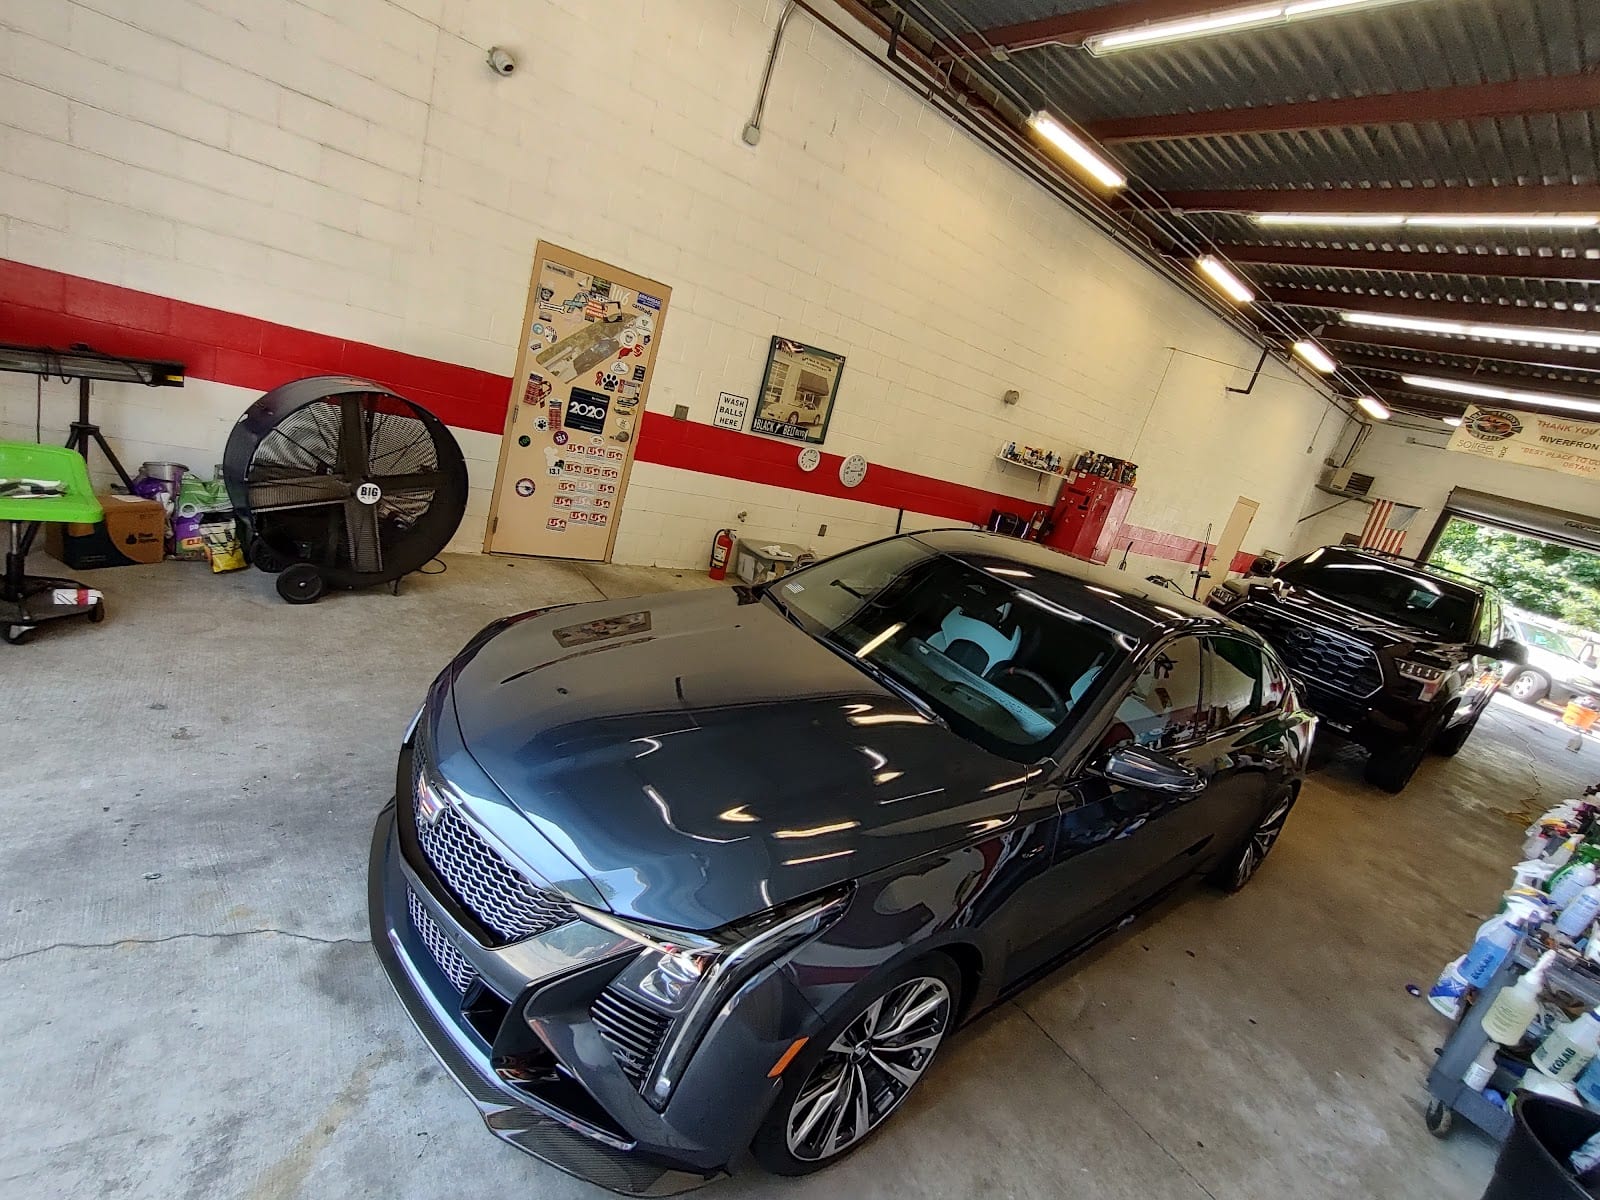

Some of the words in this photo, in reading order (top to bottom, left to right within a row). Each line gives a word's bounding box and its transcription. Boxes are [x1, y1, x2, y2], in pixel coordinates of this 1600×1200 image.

[724, 396, 745, 408] WASH
[569, 401, 605, 419] 2020
[719, 406, 744, 418] BALLS
[719, 416, 739, 427] HERE
[1537, 420, 1573, 432] THANK
[1575, 426, 1600, 436] YOU
[549, 467, 560, 475] 13.1
[361, 486, 379, 497] BIG
[1548, 1047, 1577, 1075] ECOLAB
